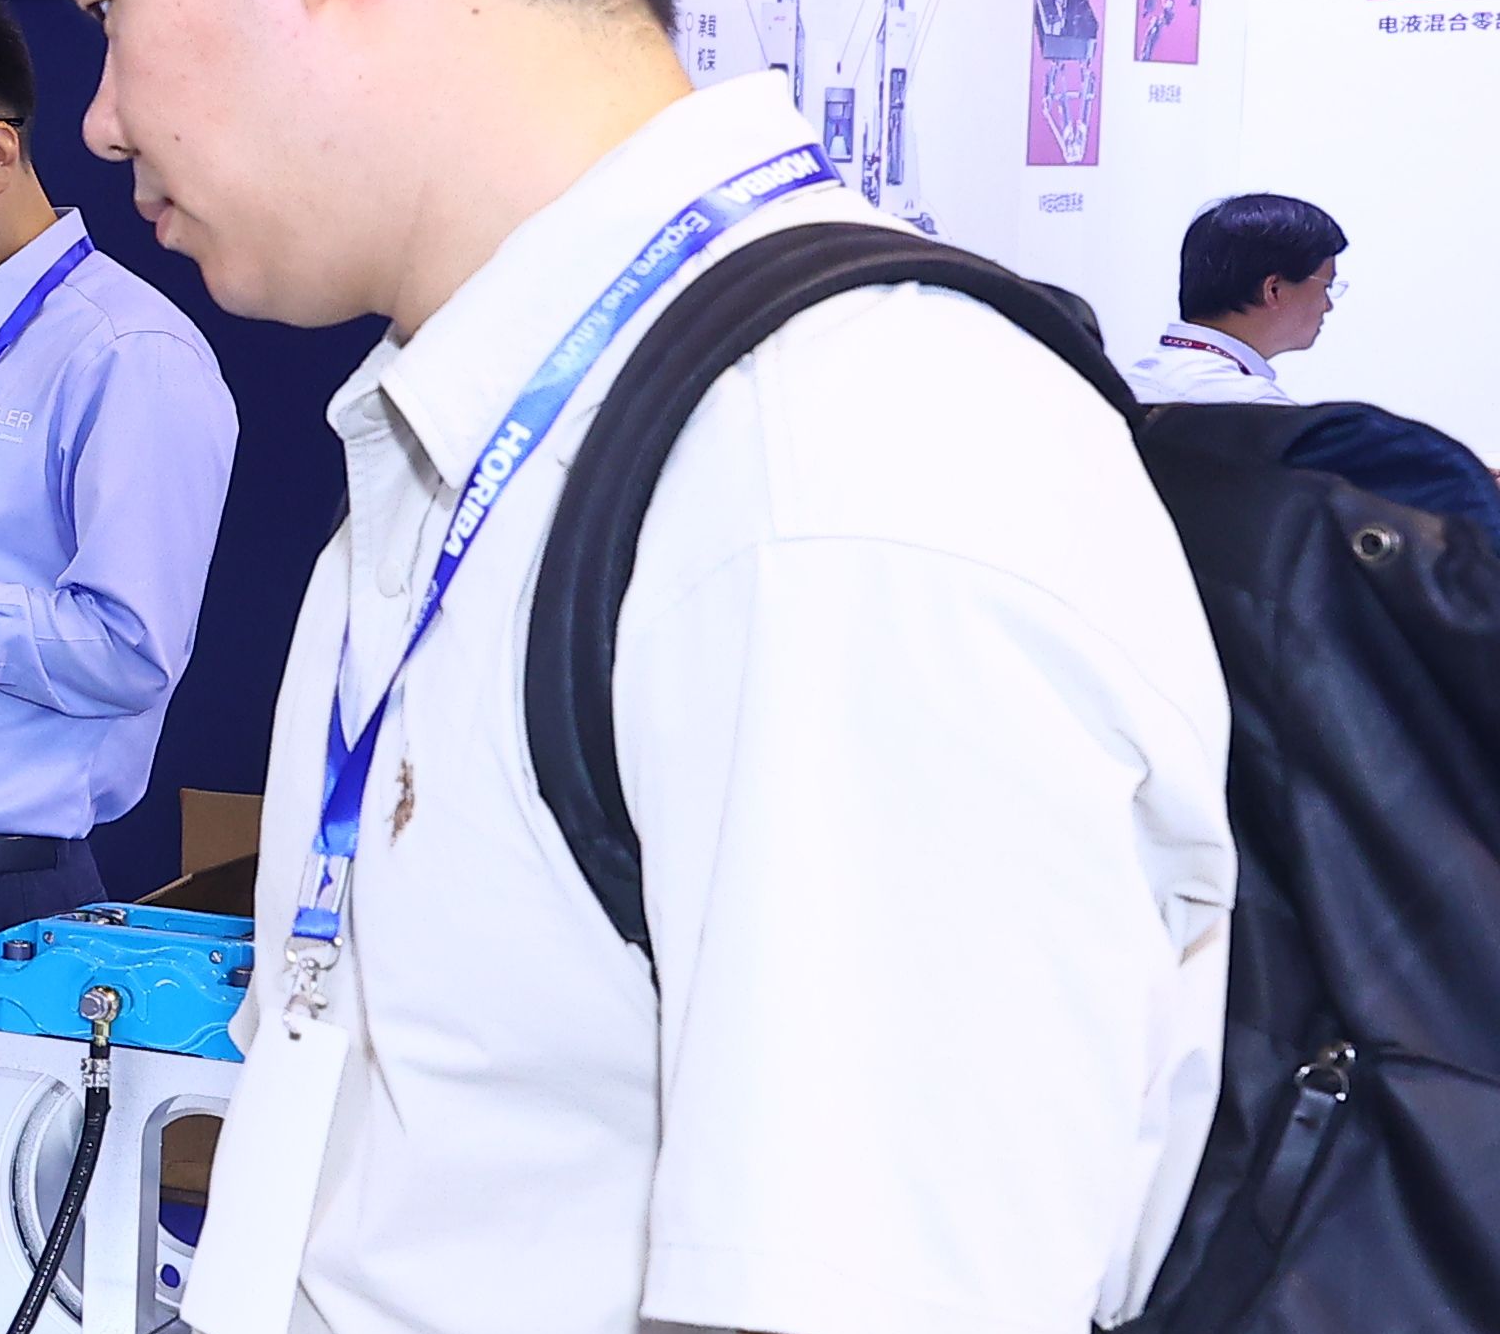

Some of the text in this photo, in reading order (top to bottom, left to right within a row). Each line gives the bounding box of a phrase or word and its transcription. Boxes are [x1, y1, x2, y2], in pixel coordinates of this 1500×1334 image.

[1378, 10, 1500, 34] 电液混合零
[719, 149, 822, 204] HORIBA
[632, 210, 712, 277] Explore
[444, 419, 533, 558] HORIBA
